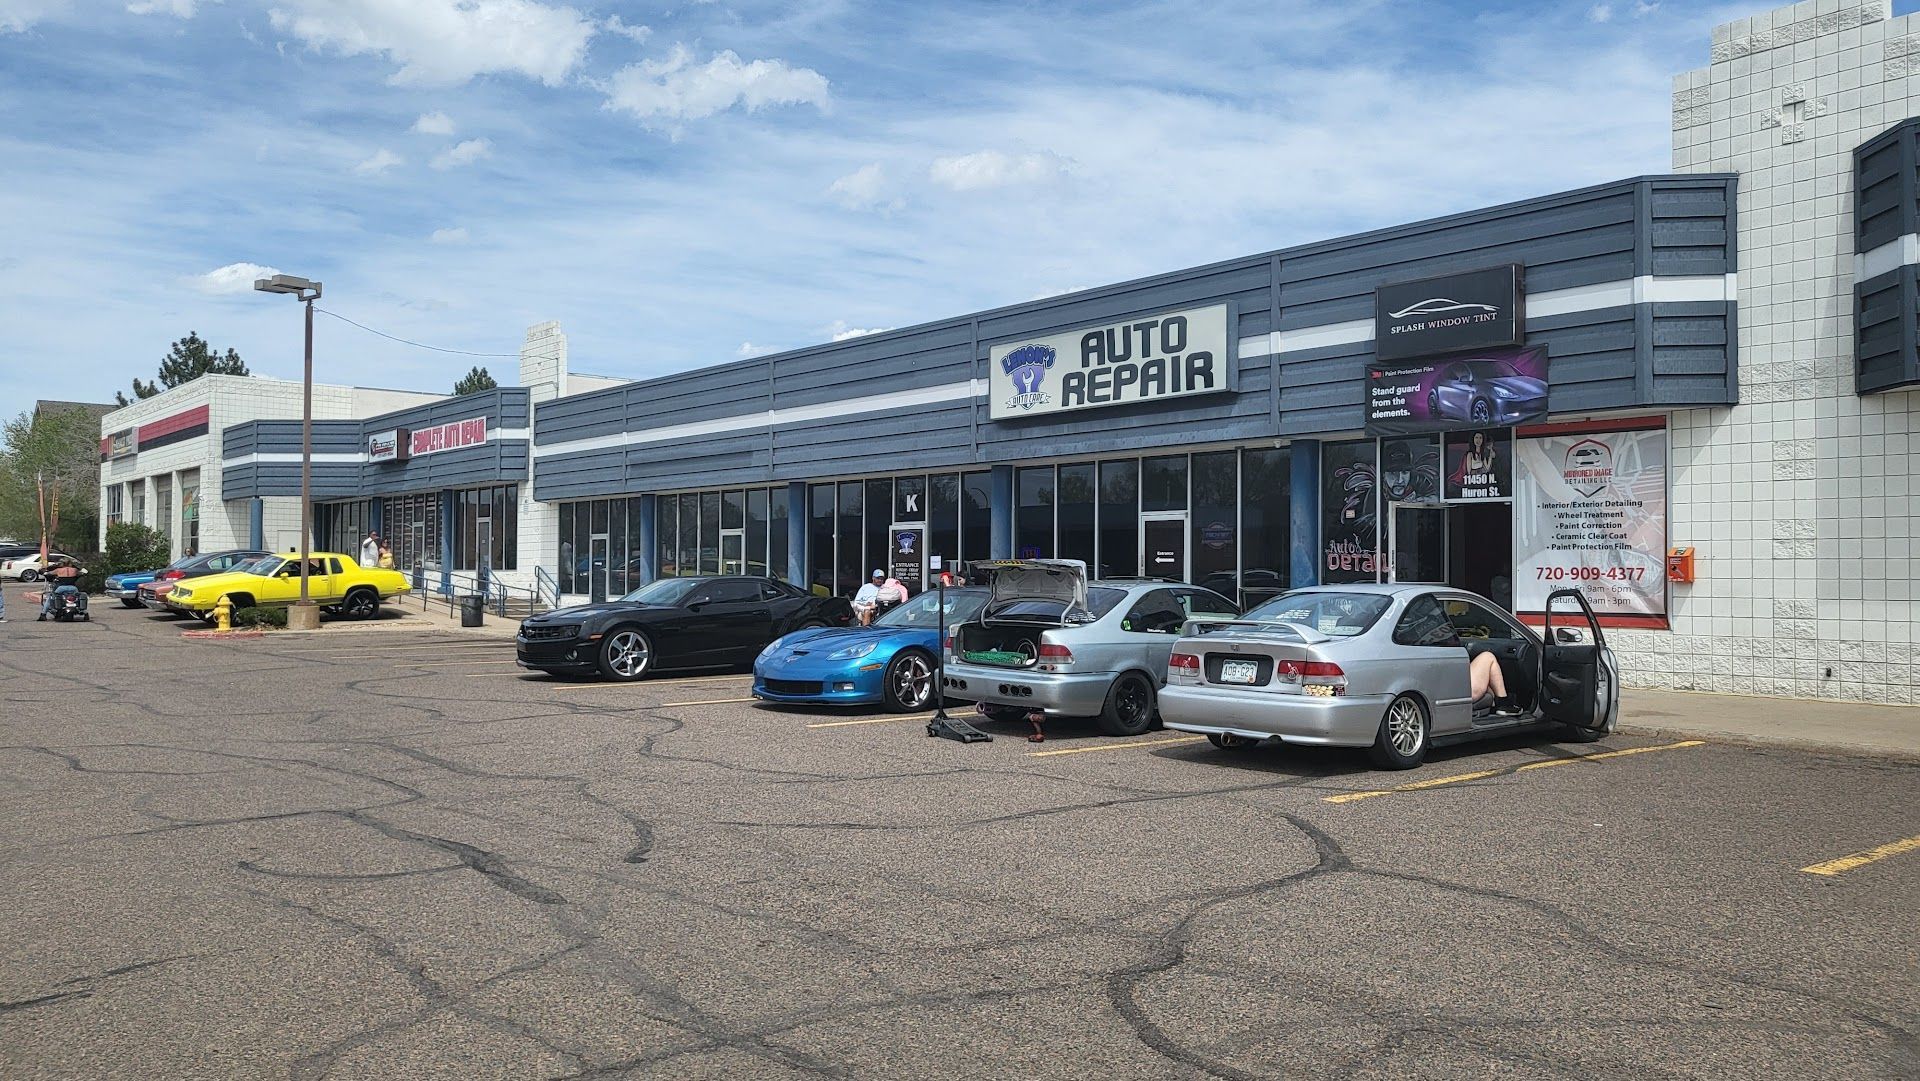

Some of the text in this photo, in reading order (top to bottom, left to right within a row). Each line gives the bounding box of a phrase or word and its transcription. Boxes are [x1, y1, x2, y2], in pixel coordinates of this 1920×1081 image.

[1390, 312, 1498, 334] SPLASH WINDOW TINT
[1081, 315, 1188, 368] AUTO
[1397, 367, 1423, 376] Protection
[1061, 350, 1214, 407] REPAIR
[1371, 383, 1421, 396] Stand guard
[1371, 397, 1406, 408] from the
[1371, 408, 1411, 419] elements.
[414, 418, 485, 455] COMPLETE AUTO REPAIR
[1593, 467, 1613, 477] IMAGE
[1462, 473, 1498, 485] 11450 N.
[1564, 476, 1612, 485] DETAILING LLC
[1461, 486, 1501, 498] Huron St.
[906, 493, 918, 513] K
[1541, 499, 1643, 510] Interior/Exterior Detailing
[1557, 511, 1624, 519] Wheel Treatment
[1559, 521, 1622, 530] Paint Correction
[1555, 532, 1628, 540] Ceramic Clear Coat
[1551, 542, 1632, 551] Paint Protection Film
[1535, 567, 1645, 581] 720-909-4377
[1586, 584, 1605, 593] 9am
[1611, 584, 1632, 594] 6pm
[1587, 596, 1606, 605] 9am
[1612, 596, 1631, 607] 3pm
